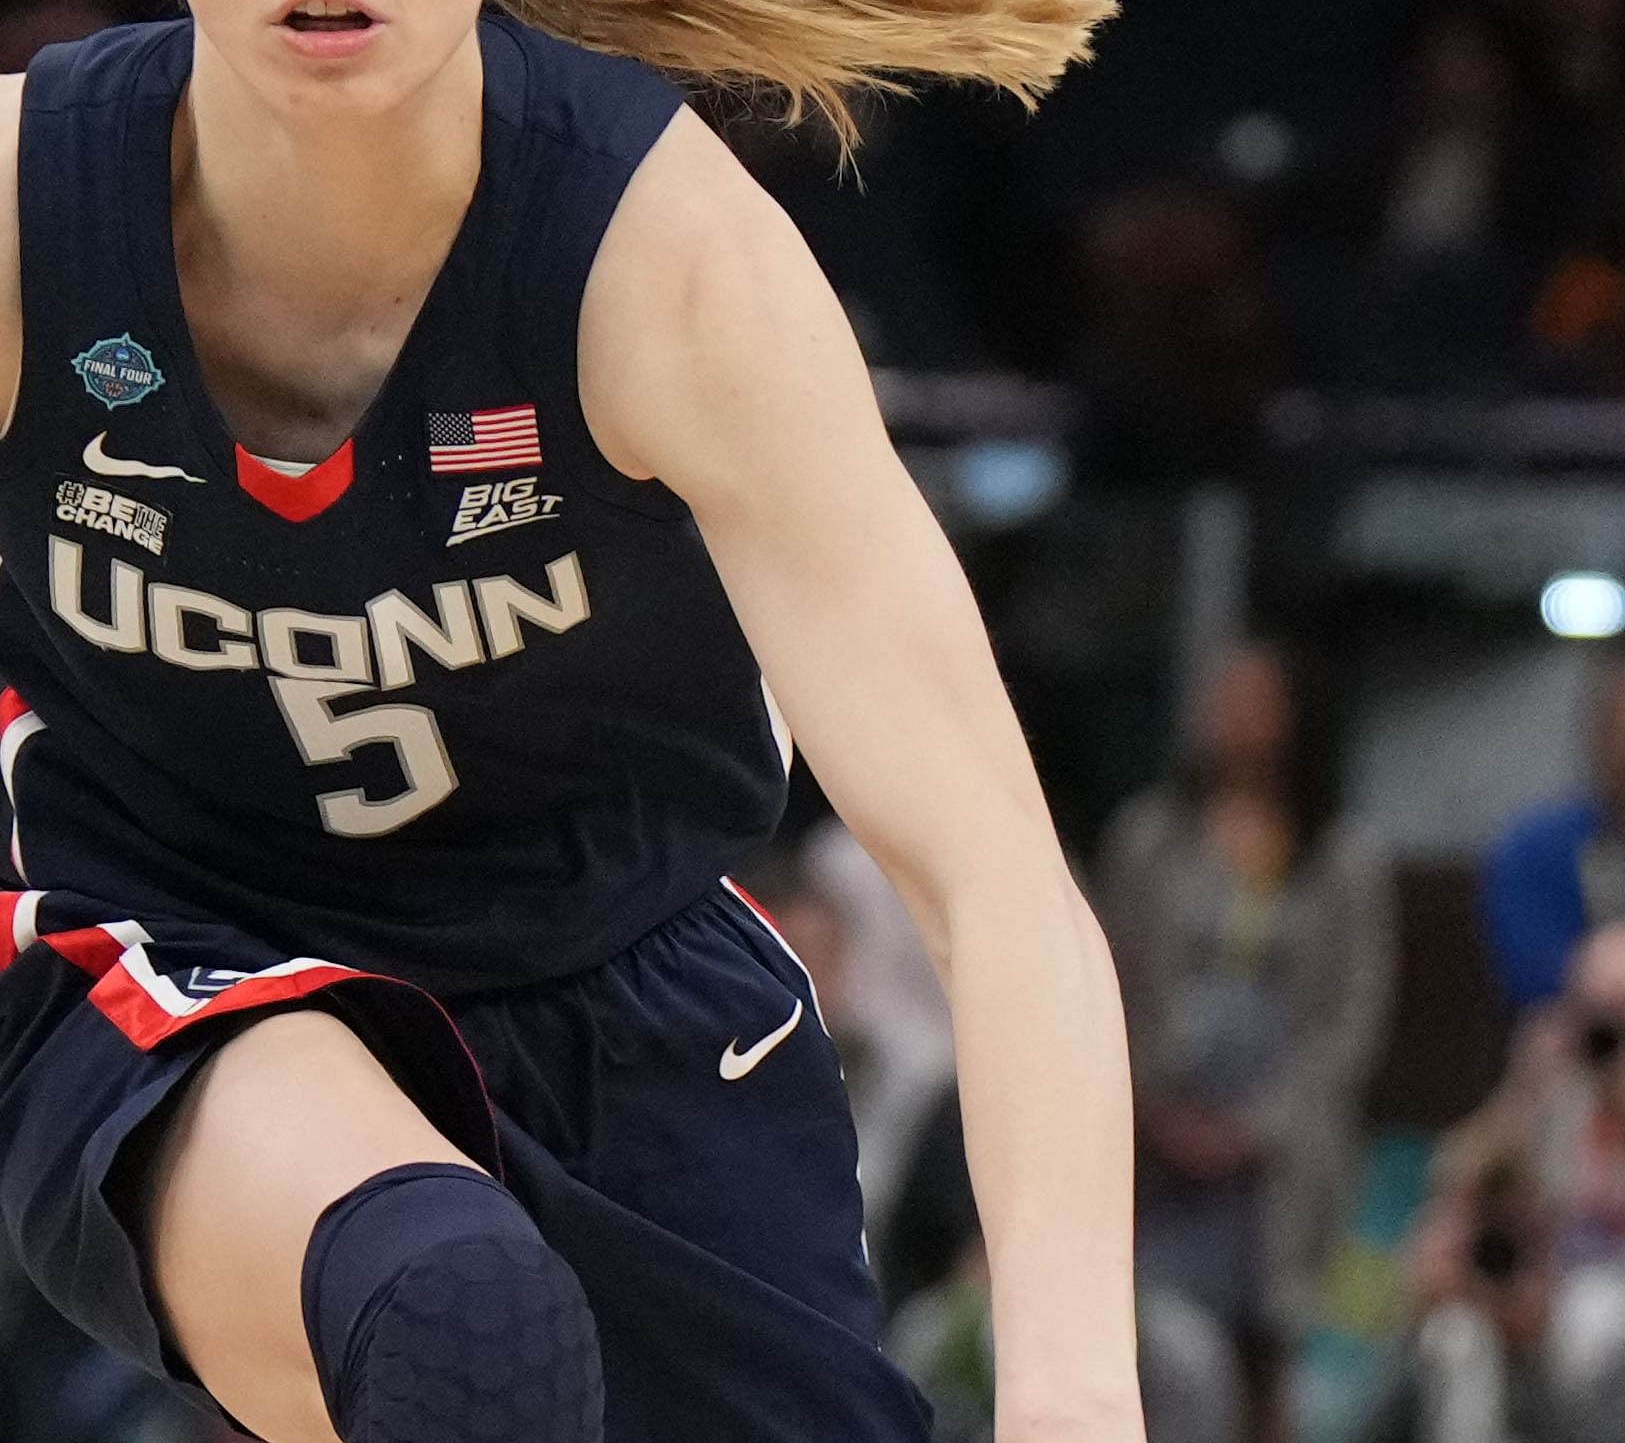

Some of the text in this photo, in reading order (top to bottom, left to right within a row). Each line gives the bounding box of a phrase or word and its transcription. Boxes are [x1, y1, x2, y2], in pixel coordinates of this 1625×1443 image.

[83, 359, 153, 386] FINAL FOUR
[452, 495, 563, 532] EAST
[458, 476, 538, 509] BIG
[56, 504, 164, 556] CHANGE
[47, 534, 591, 690] UCONN
[268, 675, 459, 838] 5
